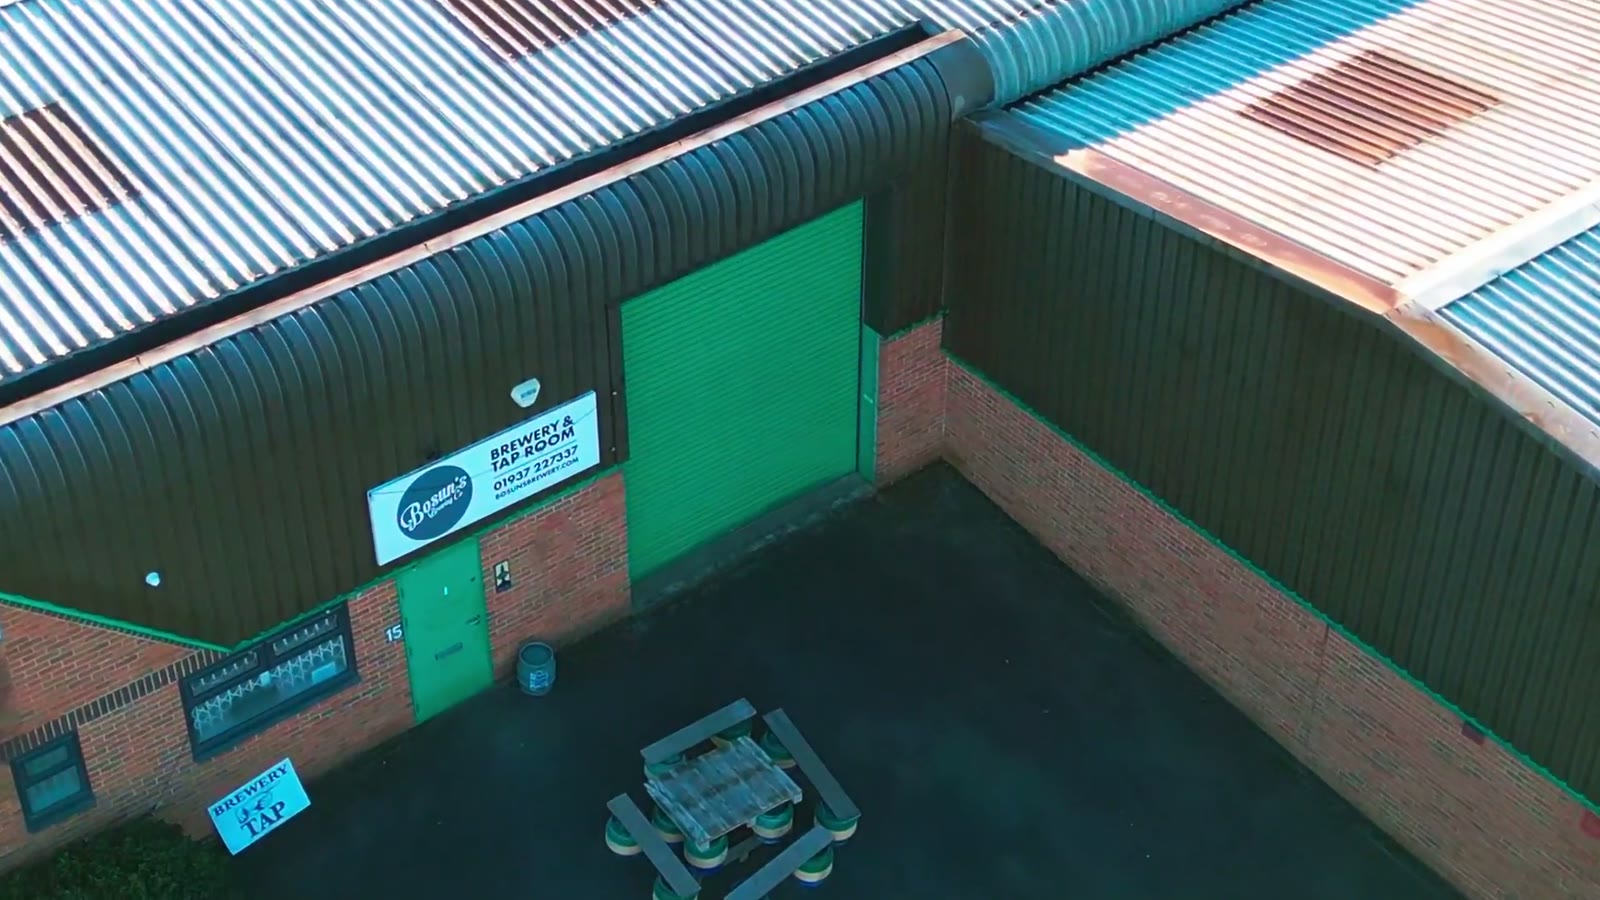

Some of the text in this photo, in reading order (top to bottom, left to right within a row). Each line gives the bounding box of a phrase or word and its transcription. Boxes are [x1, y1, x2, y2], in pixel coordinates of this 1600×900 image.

[491, 415, 574, 461] BREWERY &
[491, 426, 575, 472] TAP ROOM
[494, 445, 578, 491] 01937 227337
[495, 457, 579, 500] BOSUNSBREWERY.COM
[400, 475, 467, 532] Bosun's
[386, 624, 403, 642] 15
[213, 763, 289, 817] BREWERY
[240, 800, 286, 838] TAP
